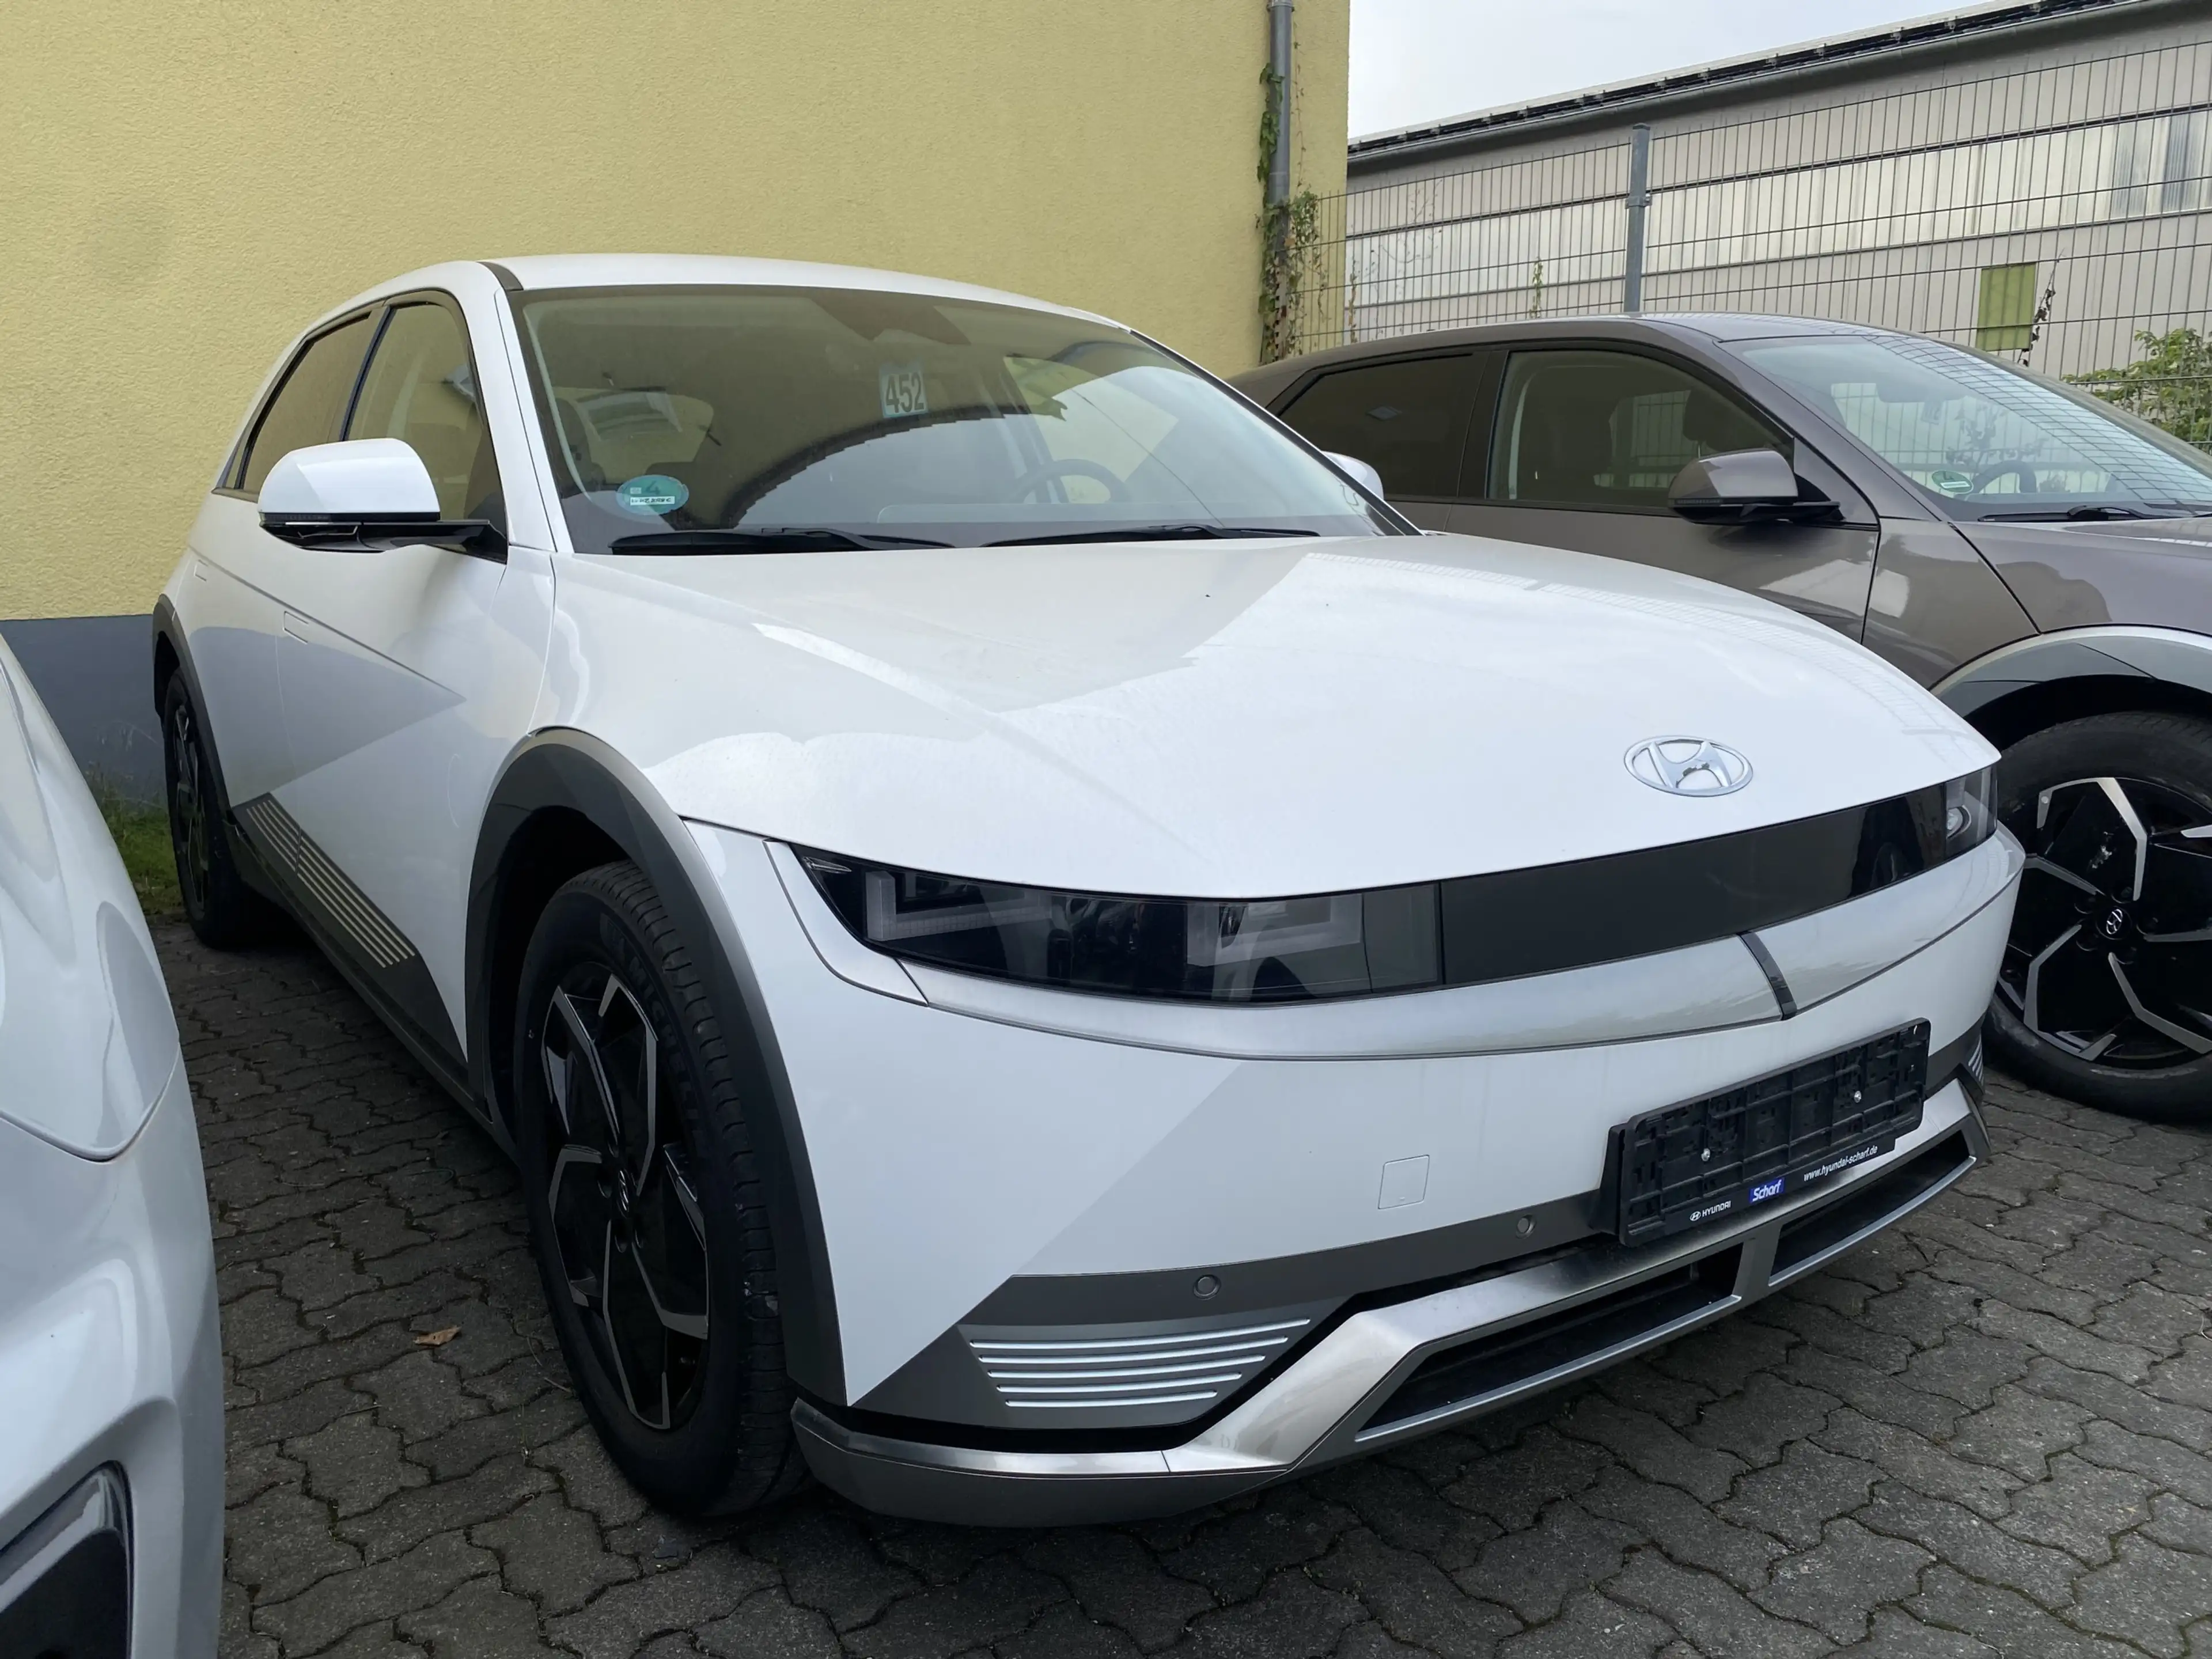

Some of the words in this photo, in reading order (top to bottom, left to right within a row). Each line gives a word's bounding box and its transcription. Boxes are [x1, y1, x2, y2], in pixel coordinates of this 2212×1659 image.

[885, 373, 925, 413] 452
[1804, 1145, 1878, 1181] www.hyundai-scharf.de
[1752, 1179, 1782, 1202] Scharf
[1702, 1200, 1732, 1218] HYUNDAI
